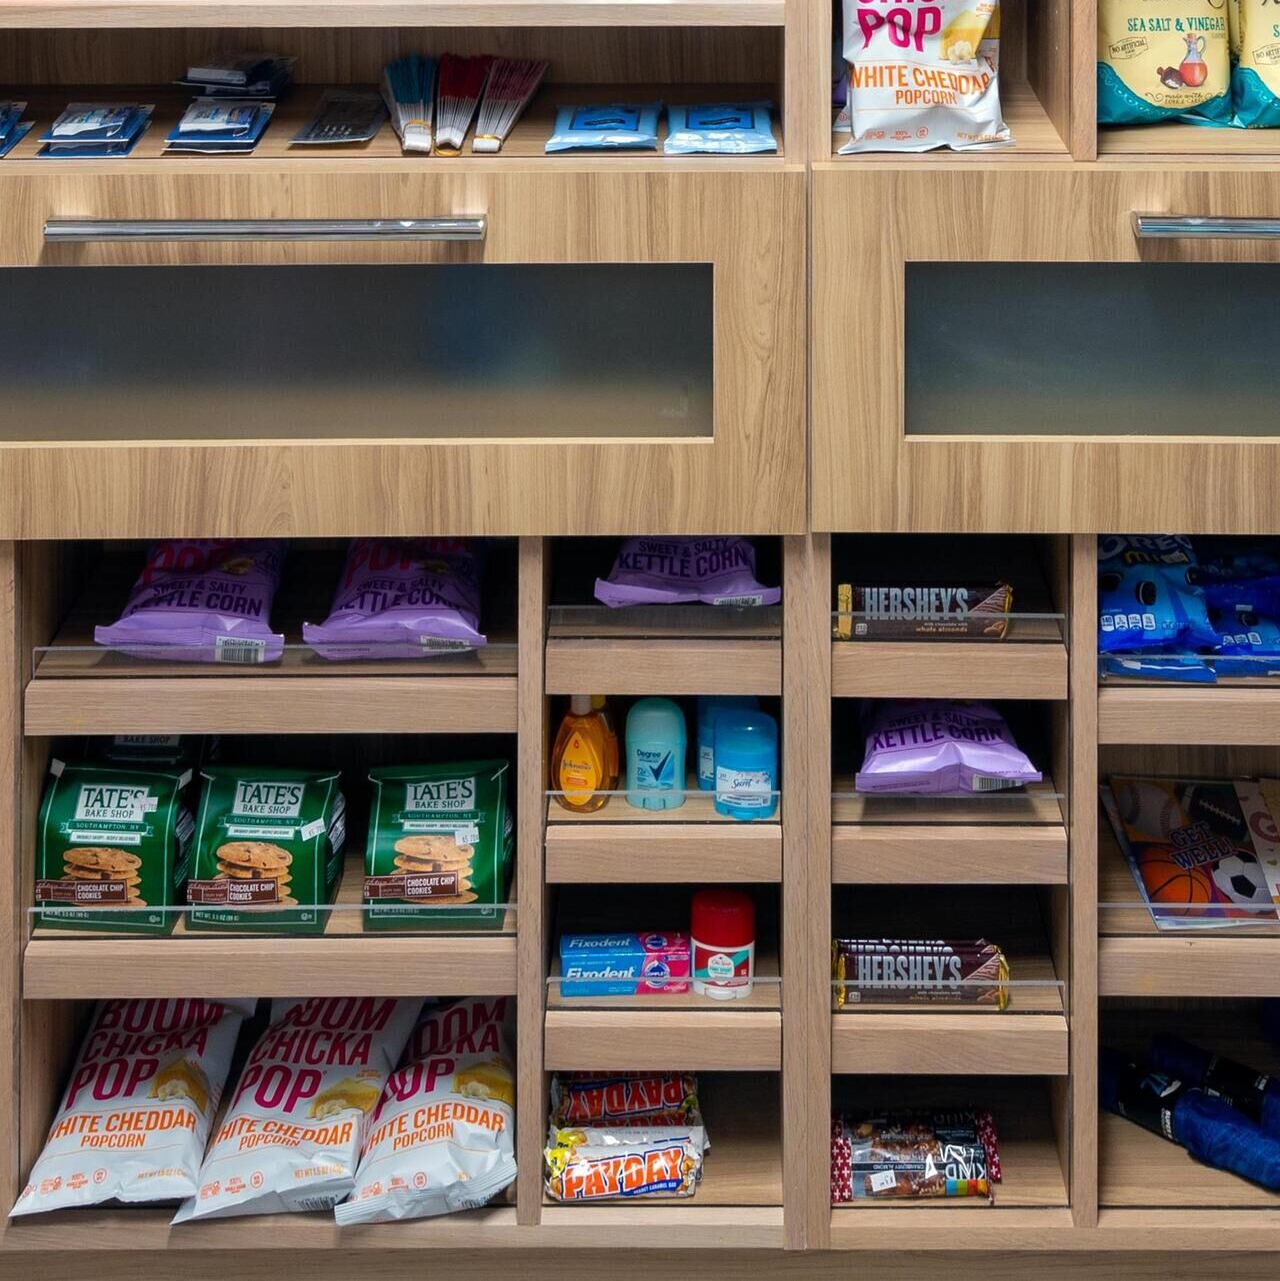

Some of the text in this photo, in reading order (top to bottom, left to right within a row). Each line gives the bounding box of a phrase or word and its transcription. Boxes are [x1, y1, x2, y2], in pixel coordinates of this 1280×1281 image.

[856, 6, 942, 52] POP
[1127, 16, 1225, 31] SEA SALT VINEGAR
[896, 90, 958, 105] POPCORN
[639, 537, 729, 556] SWEET SALTY
[620, 543, 748, 578] KETTLE CORN
[864, 587, 969, 621] HERSHEY'S
[872, 722, 1002, 751] KETTLE CORN
[636, 749, 661, 758] Degree
[240, 783, 302, 805] TATE'S
[242, 805, 291, 814] BAKE SHOP
[415, 799, 466, 809] BAKE SHOP
[85, 809, 134, 819] BAKE SHOP
[1170, 821, 1211, 848] GET
[1171, 837, 1235, 869] WELL!
[407, 877, 455, 887] CHOCOLATE CHIP
[407, 886, 432, 895] COOKIES
[77, 892, 102, 900] COOKIES
[229, 892, 252, 900] COOKIES
[569, 937, 631, 948] Fixodent
[566, 966, 635, 981] Fixodent
[858, 955, 962, 989] HERSHEY'S
[65, 1058, 159, 1111] POP
[105, 1109, 196, 1134] CHEDDAR
[413, 1102, 505, 1132] CHEDDAR
[80, 1134, 146, 1148] POPCORN
[393, 1122, 454, 1151] POPCORN
[563, 1148, 684, 1199] PAYDAY
